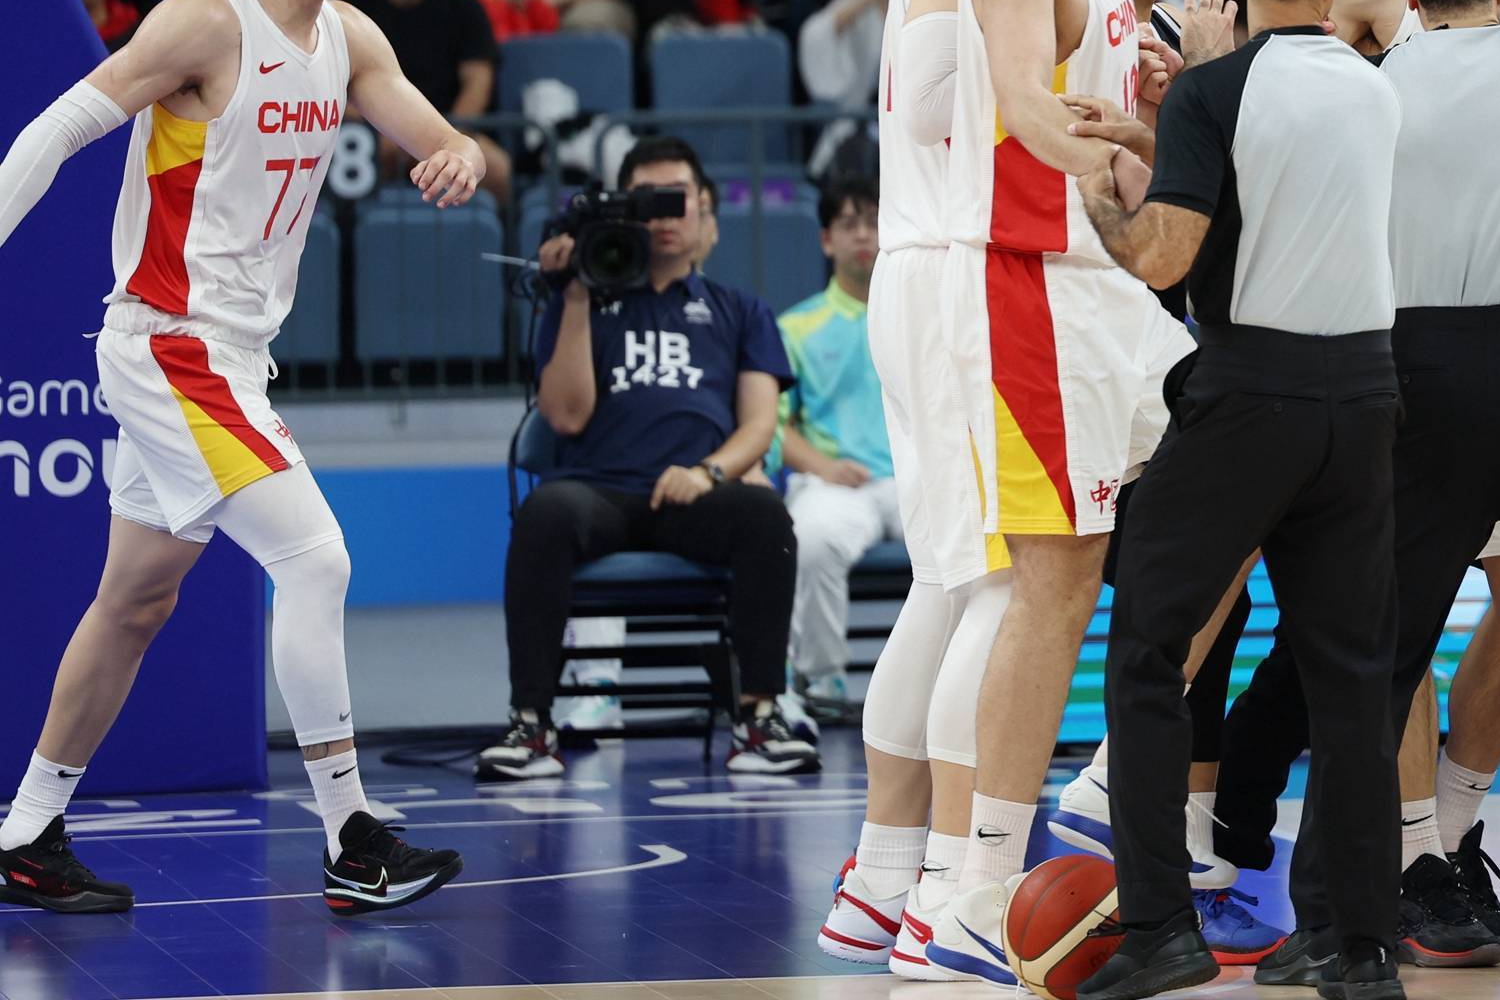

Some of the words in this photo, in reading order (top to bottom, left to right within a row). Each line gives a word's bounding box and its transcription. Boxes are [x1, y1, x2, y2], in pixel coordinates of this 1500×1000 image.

[1106, 0, 1137, 47] CHIN
[257, 99, 340, 134] CHINA
[263, 156, 322, 241] 77
[625, 330, 691, 370] HB
[0, 376, 113, 418] ame
[610, 364, 704, 394] 1427
